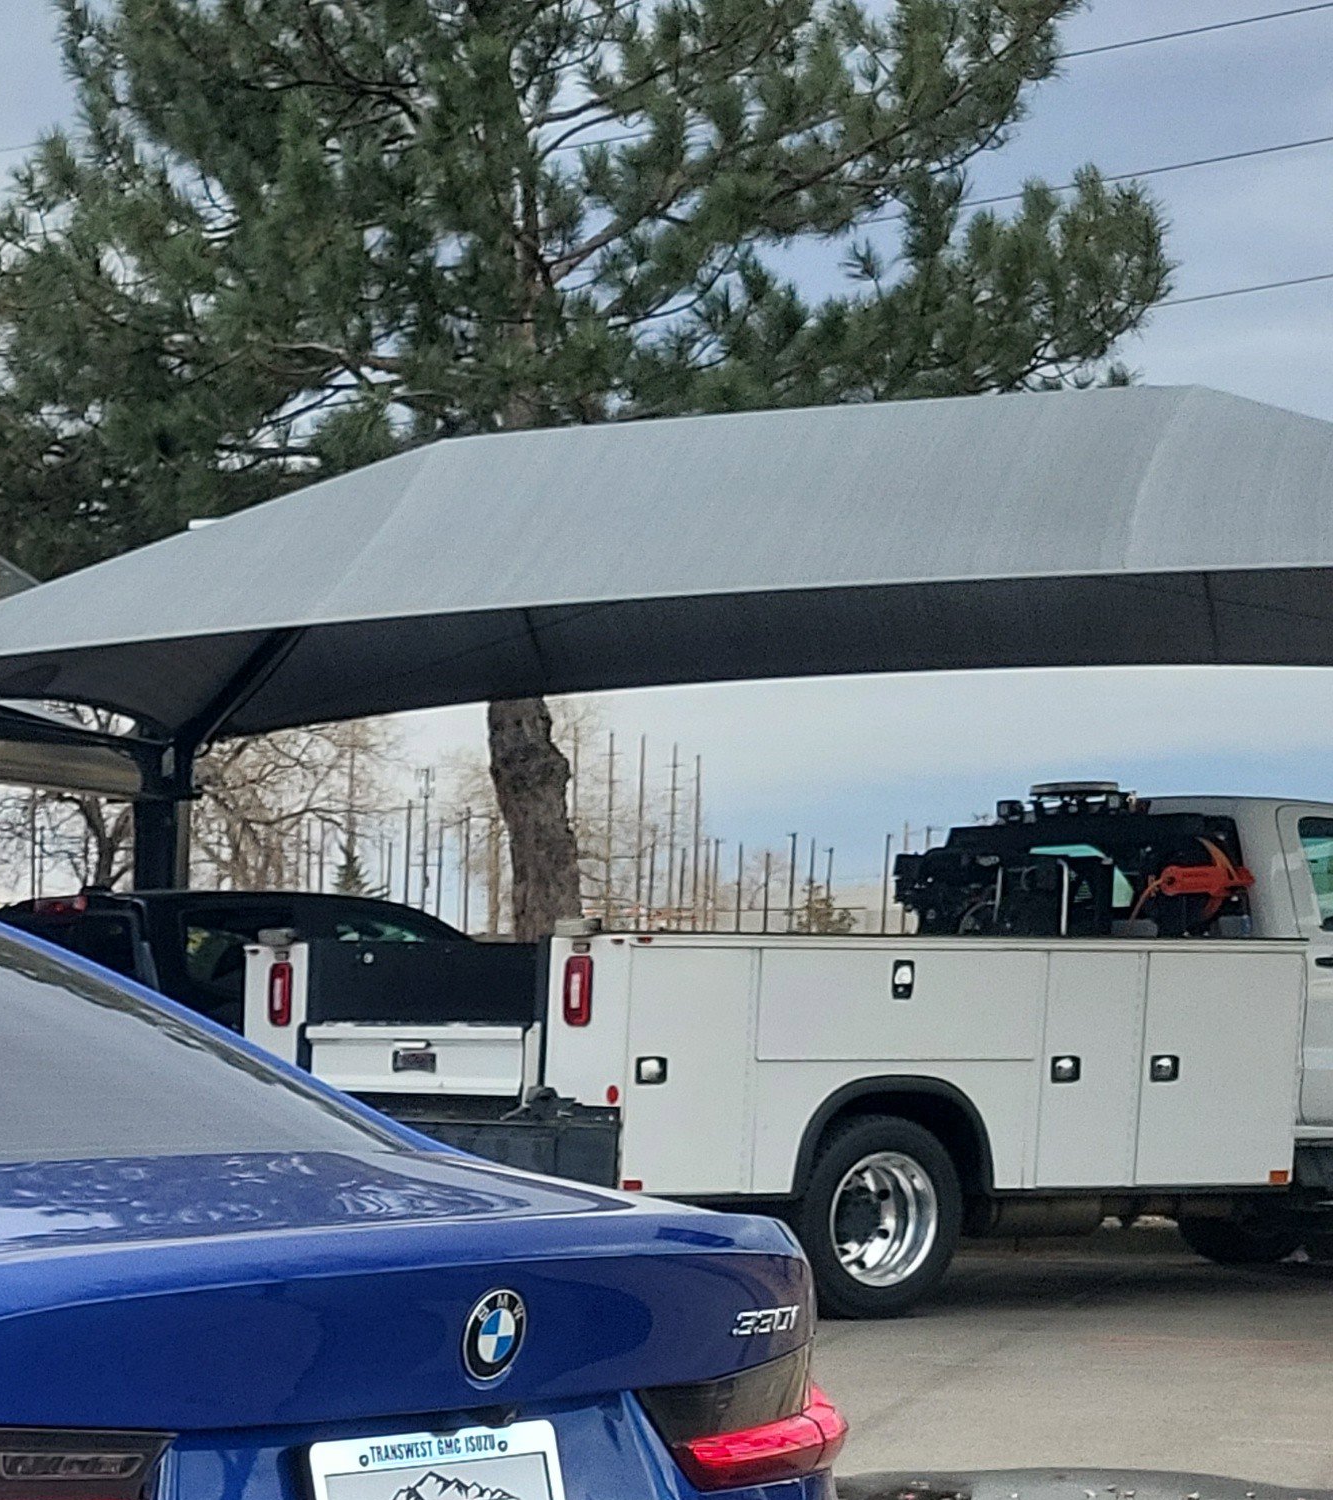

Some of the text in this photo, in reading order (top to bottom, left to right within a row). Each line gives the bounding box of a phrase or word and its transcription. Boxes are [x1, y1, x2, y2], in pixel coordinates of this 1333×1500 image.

[476, 1294, 525, 1322] BMW
[732, 1305, 800, 1336] 330i
[369, 1434, 496, 1463] TRANSWEST GMC ISUZU
